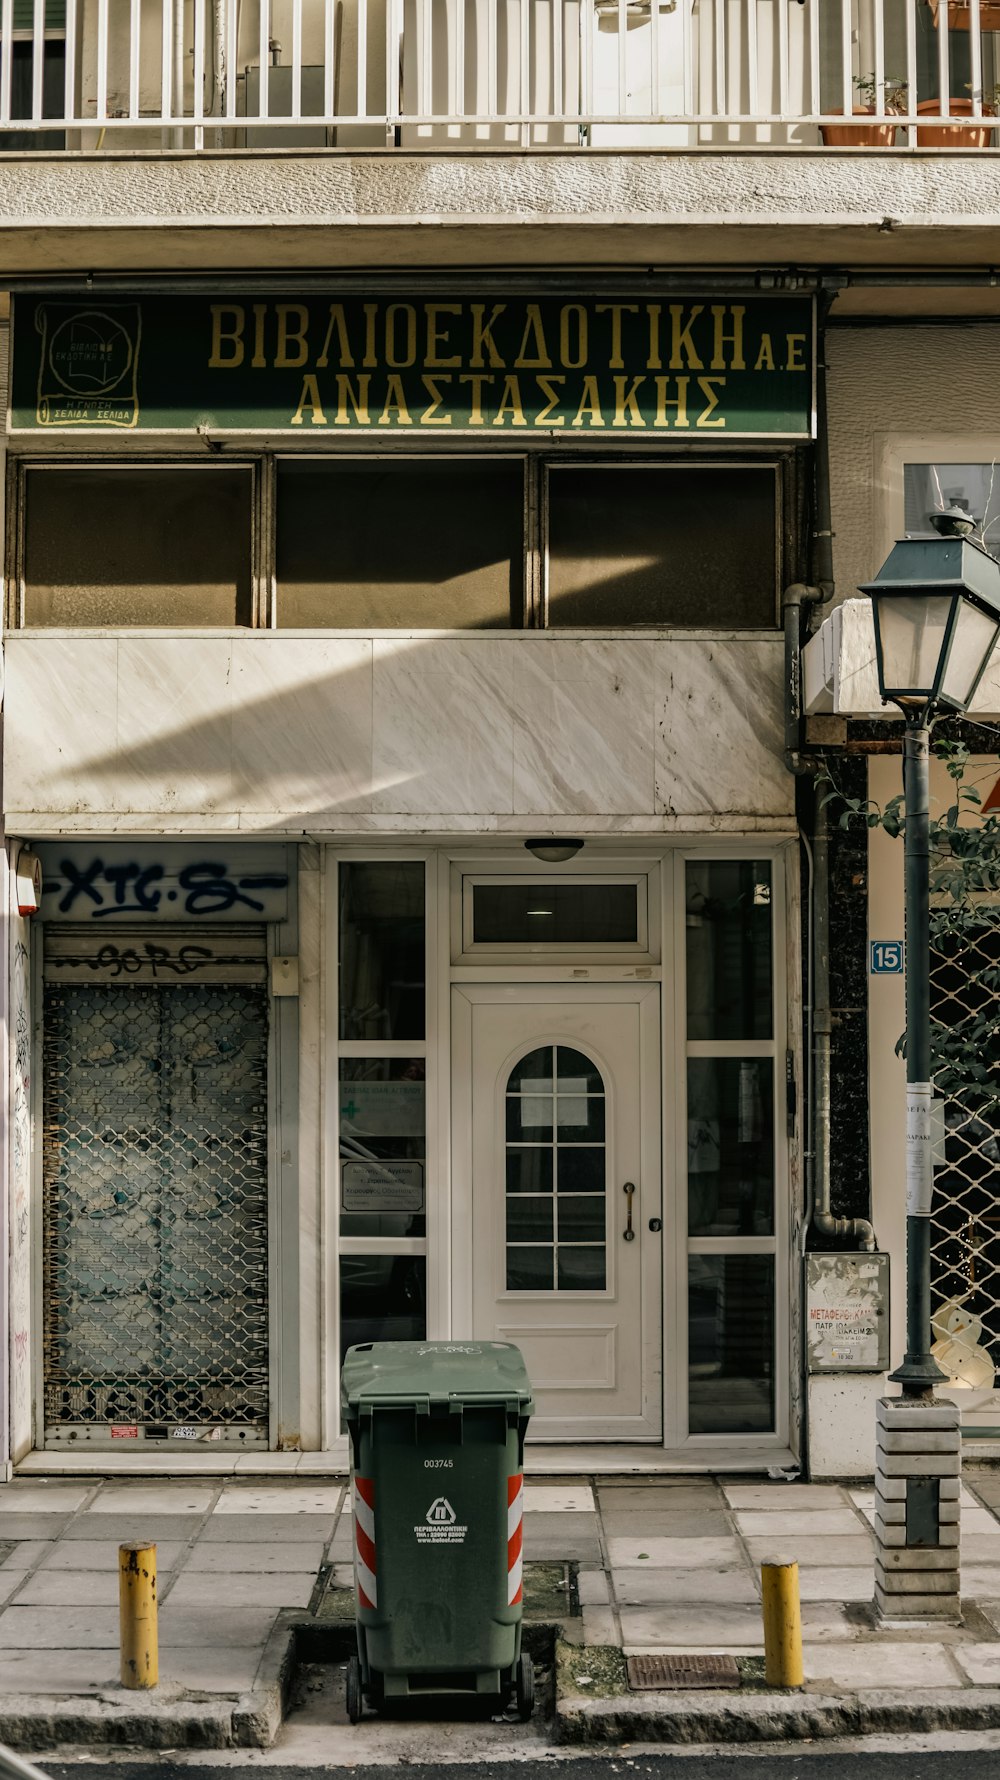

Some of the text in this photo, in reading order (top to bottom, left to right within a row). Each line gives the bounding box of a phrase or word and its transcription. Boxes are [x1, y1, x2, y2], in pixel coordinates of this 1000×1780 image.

[208, 303, 746, 370] ΒΙΒΛΙΟΕΚΔΟΤΙΚΗ
[55, 352, 97, 361] ΕΚΔΟΤΙΚΗ
[290, 374, 727, 428] ΑΝΑΣΤΑΣΑΚΗΣ
[54, 409, 130, 420] ΣΕΛΙΔΑ ΣΕΛΙΔΑ
[875, 946, 899, 968] 15
[424, 1460, 453, 1469] 003745
[435, 1506, 447, 1520] Π
[414, 1525, 468, 1533] ΠΕΡΙΒΑΛΛΟΝΤΙΚΗ
